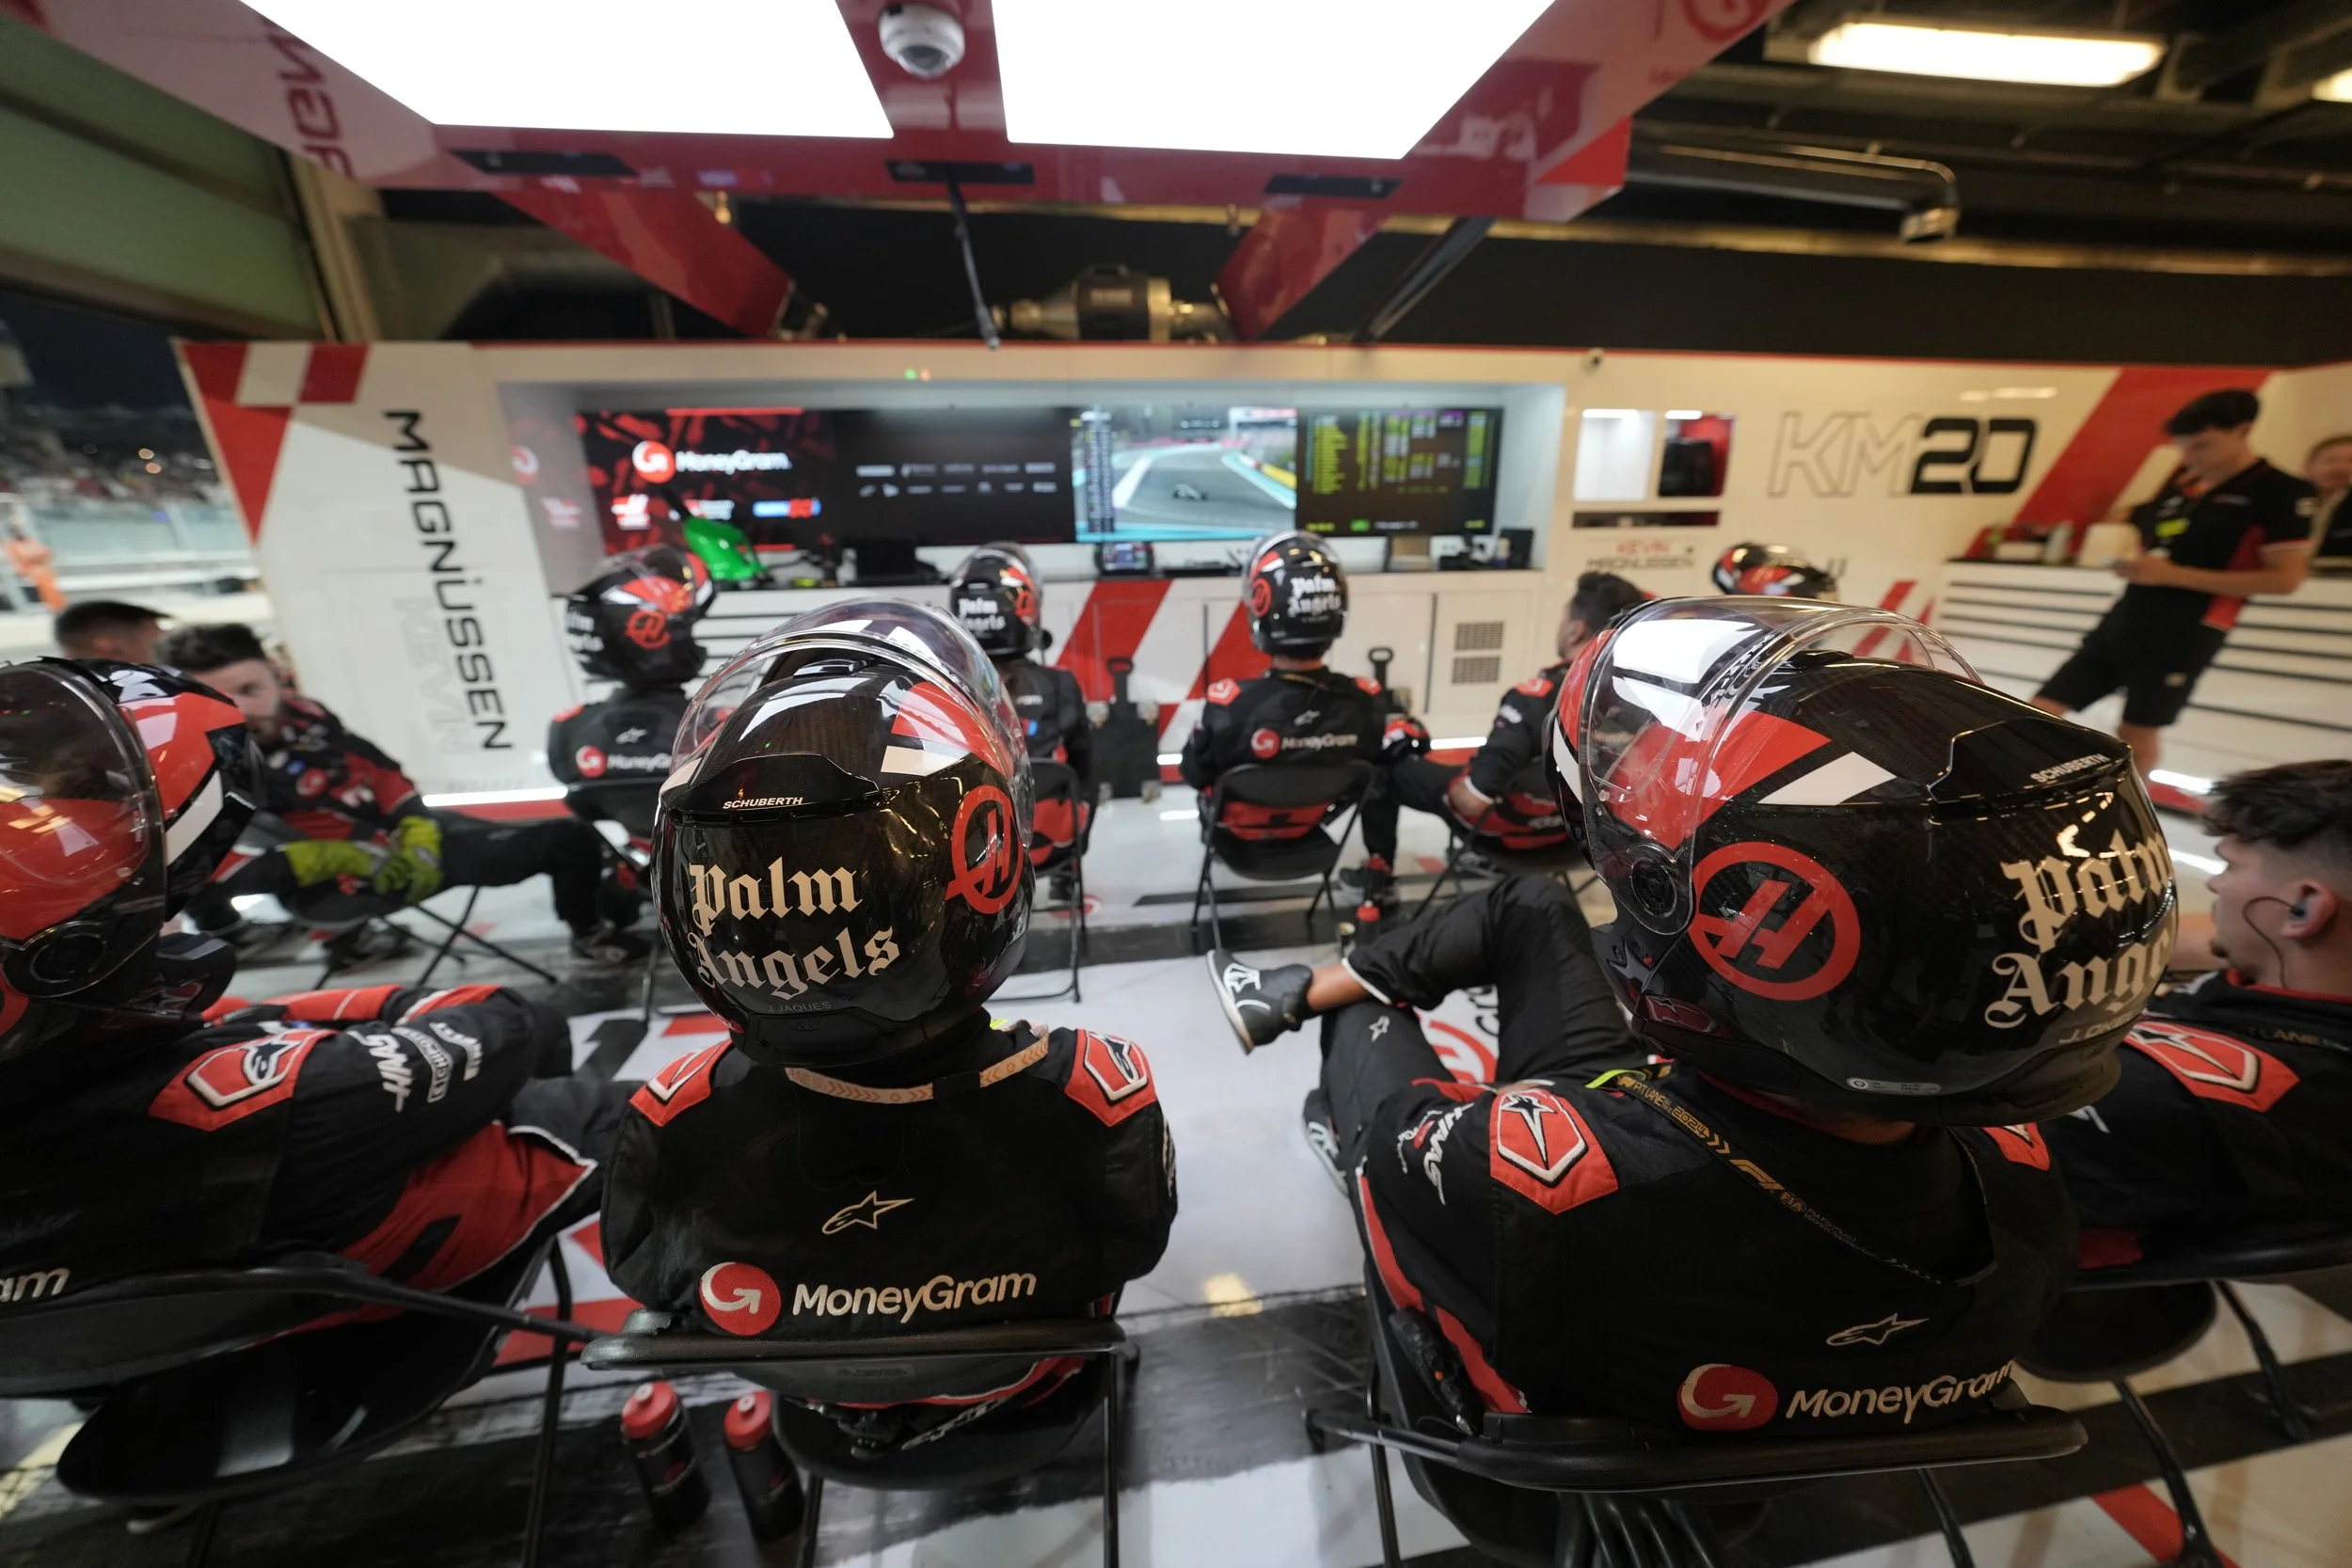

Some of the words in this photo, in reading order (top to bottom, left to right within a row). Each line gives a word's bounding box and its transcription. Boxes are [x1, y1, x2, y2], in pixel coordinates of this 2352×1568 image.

[675, 450, 792, 475] MoneyGram
[1280, 732, 1359, 751] MoneyGram
[2030, 753, 2111, 783] SCHUBERTH
[723, 797, 803, 810] SCHUBERTH
[689, 856, 863, 937] Palm
[687, 927, 900, 1001] Angels
[1985, 927, 2172, 1028] Ange
[1672, 1105, 1709, 1138] 2024
[792, 1273, 1037, 1323] MoneyGram
[1786, 1361, 2010, 1424] MoneyGram
